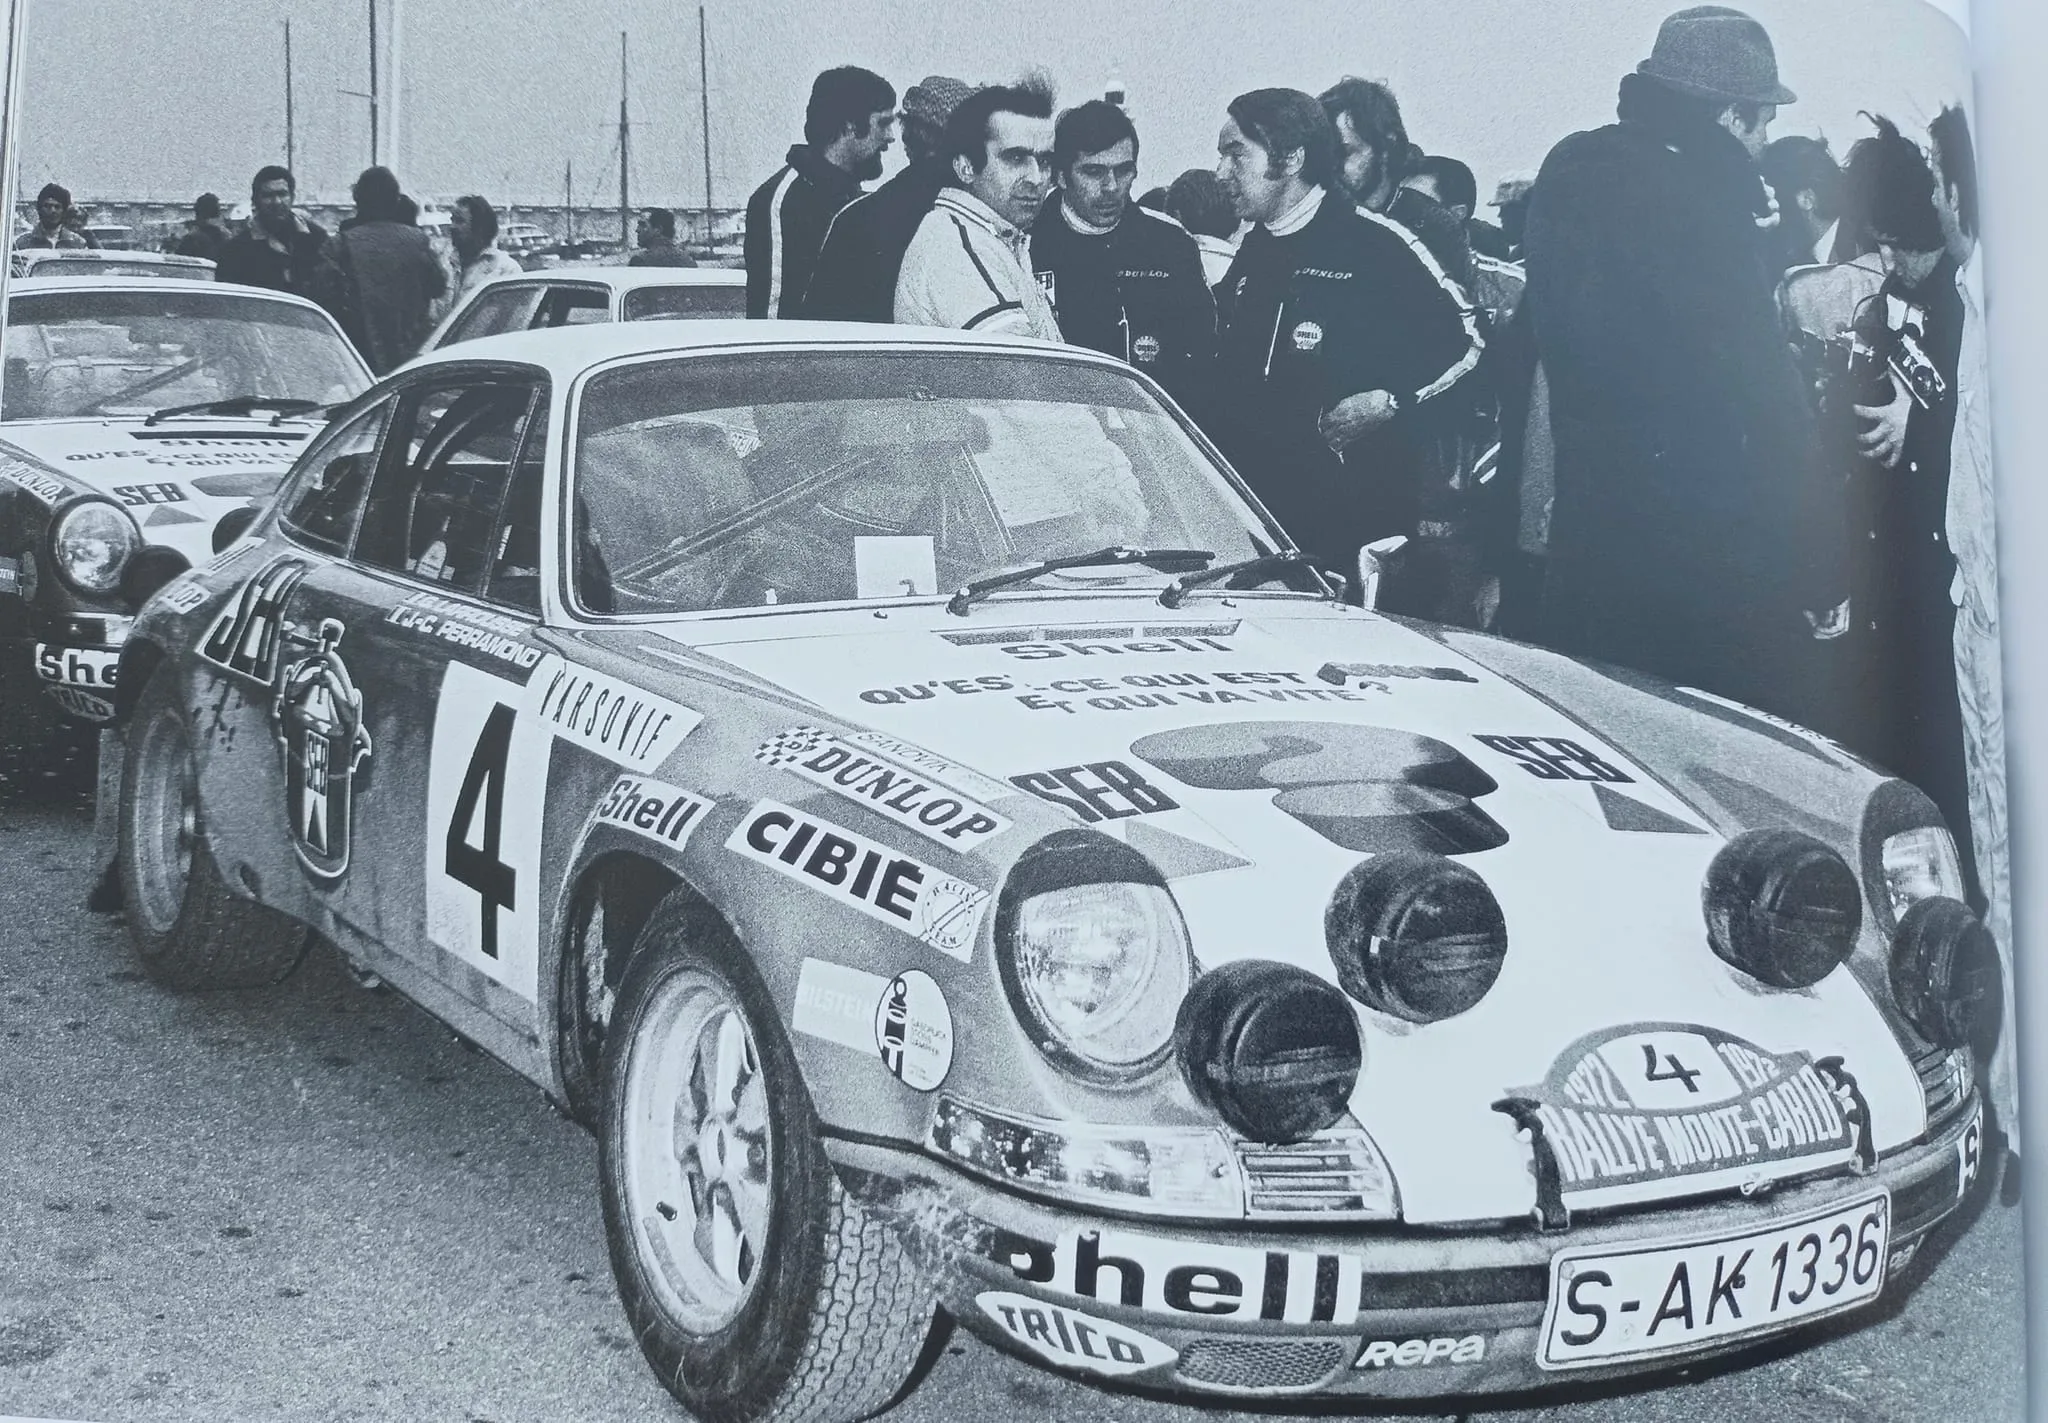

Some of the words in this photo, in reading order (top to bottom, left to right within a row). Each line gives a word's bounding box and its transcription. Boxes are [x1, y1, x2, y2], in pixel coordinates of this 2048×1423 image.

[1301, 266, 1353, 280] DUNLOP
[1296, 330, 1318, 340] SHELL
[113, 482, 189, 506] SEB
[436, 620, 542, 668] PERRAMOND
[1000, 638, 1234, 660] Shell
[1086, 691, 1179, 712] QUI
[1176, 689, 1257, 704] VA
[1249, 688, 1367, 701] VITE
[1120, 671, 1210, 688] QUI
[1211, 671, 1307, 684] EST
[540, 666, 672, 760] VARSOVIE
[1473, 734, 1637, 784] SEB
[599, 779, 701, 842] Shell
[801, 747, 998, 839] DUNLOP
[1008, 759, 1181, 823] SEB
[445, 701, 518, 960] 4
[746, 811, 925, 922] CIBIÉ
[1640, 1044, 1701, 1094] 4
[1536, 1103, 1664, 1182] RALLYE
[1653, 1064, 1843, 1168] MONTE-CARLO
[1560, 1248, 1755, 1347] S-AK
[1770, 1213, 1883, 1313] 1336
[996, 1303, 1146, 1364] TRICO
